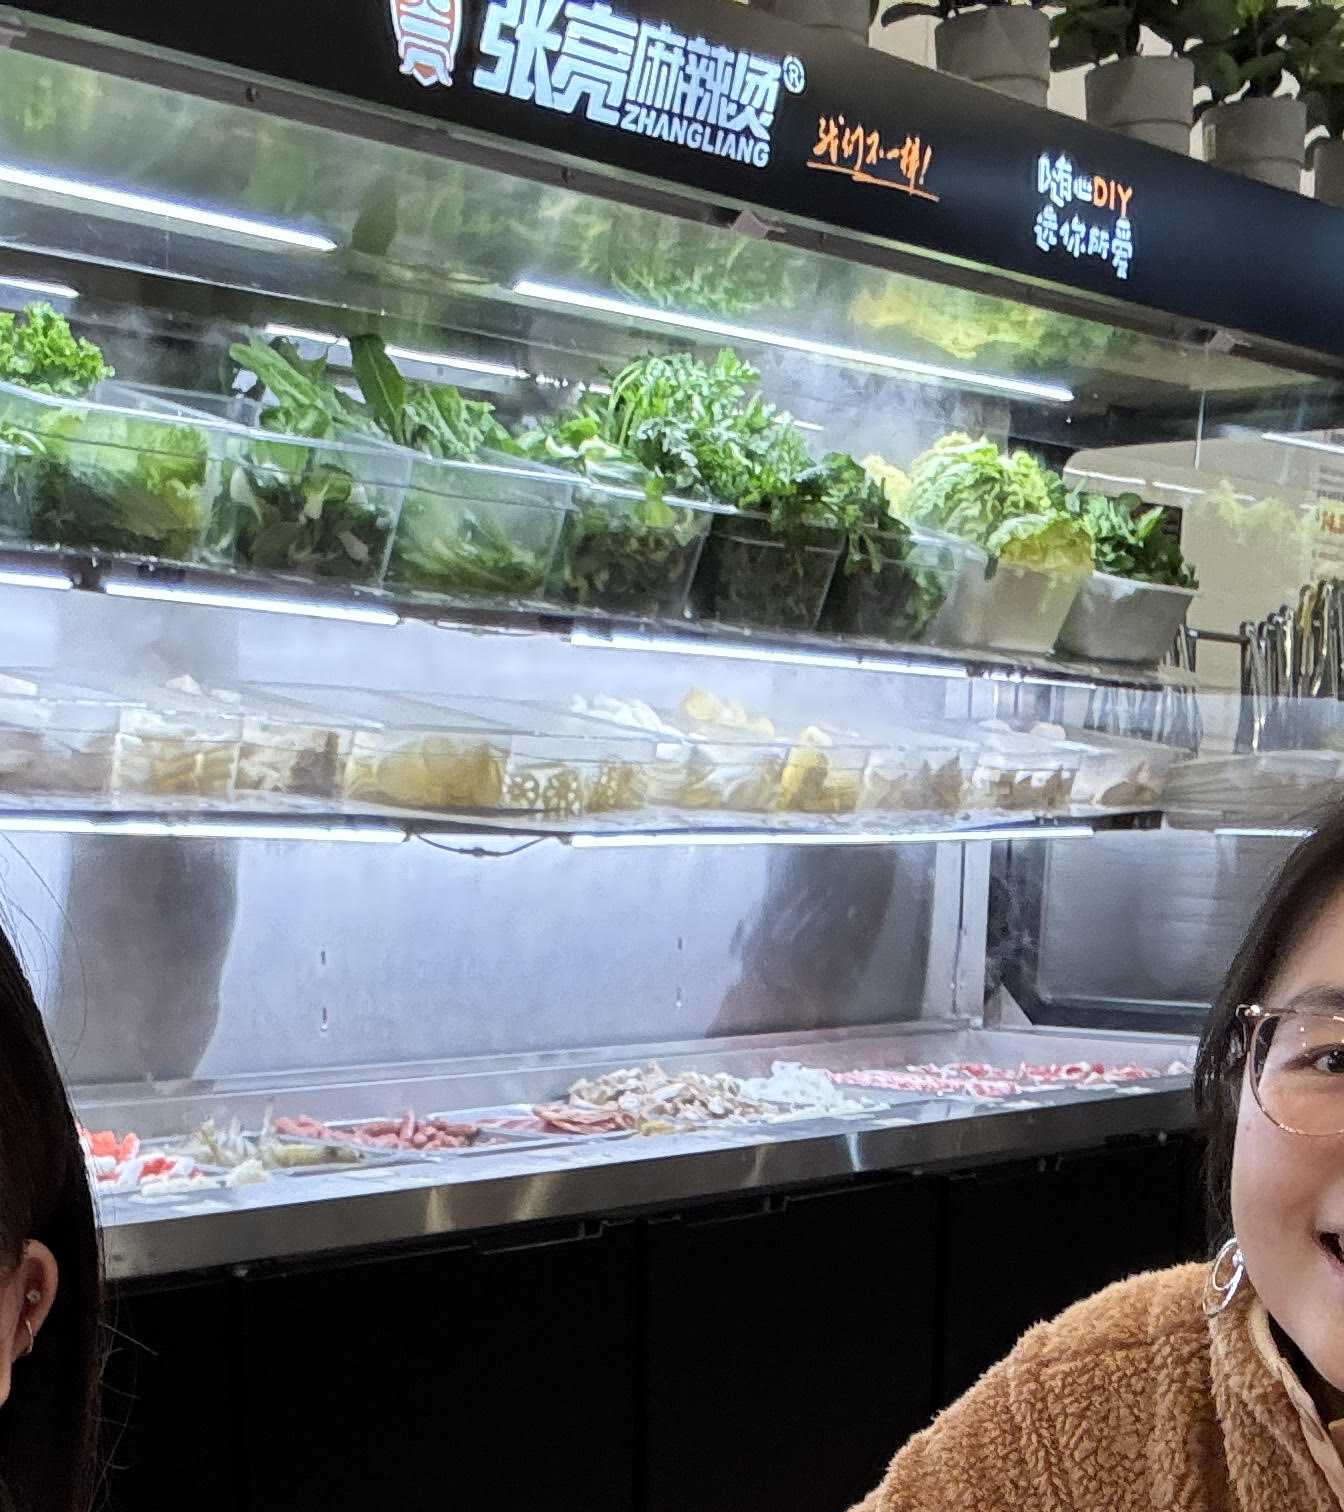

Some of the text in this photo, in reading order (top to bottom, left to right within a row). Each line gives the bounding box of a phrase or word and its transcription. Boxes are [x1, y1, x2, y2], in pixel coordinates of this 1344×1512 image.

[620, 103, 771, 169] ZHANGLIANG
[1034, 203, 1134, 280] 选你所爱
